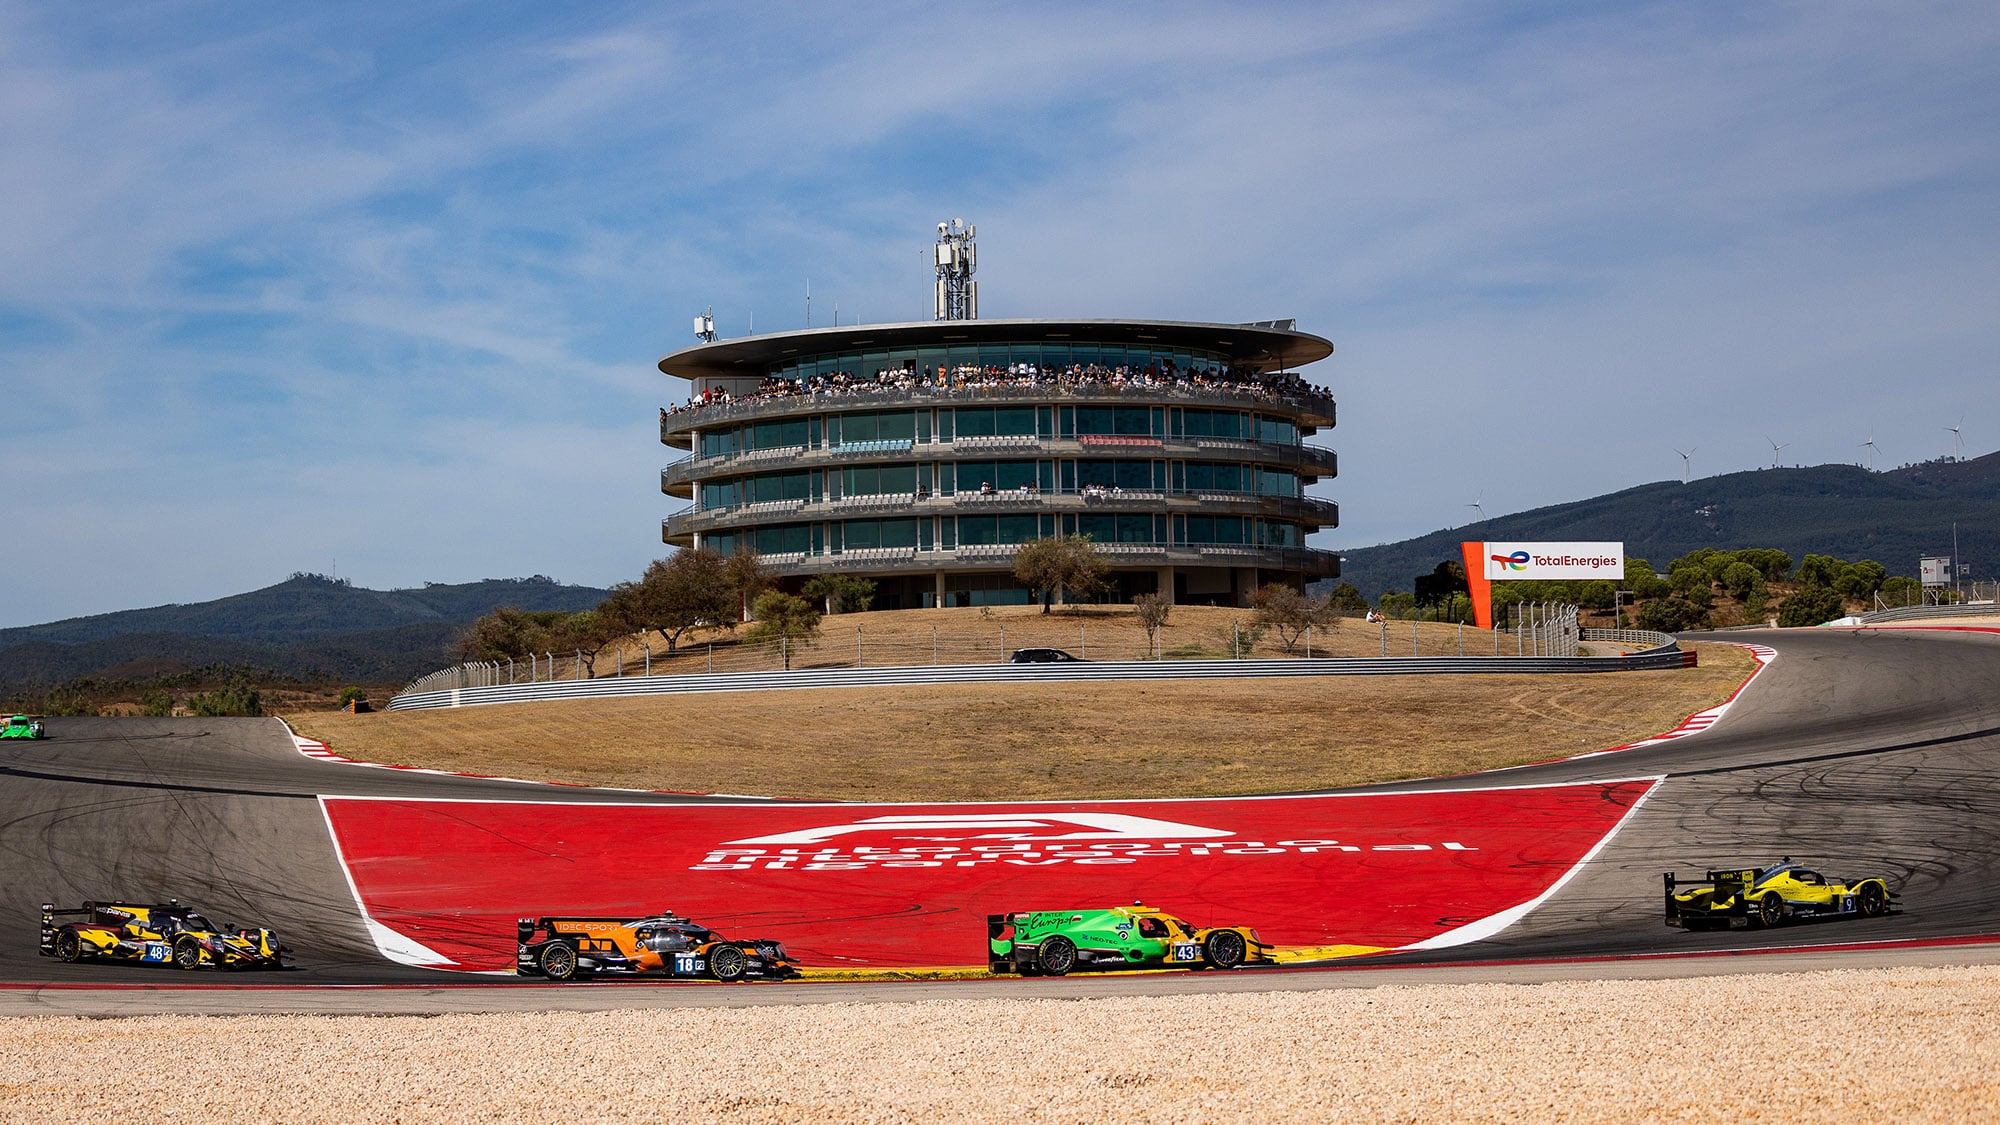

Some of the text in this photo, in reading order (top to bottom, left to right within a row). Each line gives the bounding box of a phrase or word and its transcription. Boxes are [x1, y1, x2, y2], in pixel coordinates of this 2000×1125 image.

[1532, 555, 1617, 568] TotalEnergies
[1846, 898, 1852, 911] 9
[1030, 912, 1074, 930] Europol
[150, 946, 163, 960] 48
[1177, 946, 1195, 960] 43
[677, 958, 694, 972] 18
[696, 961, 705, 969] P2
